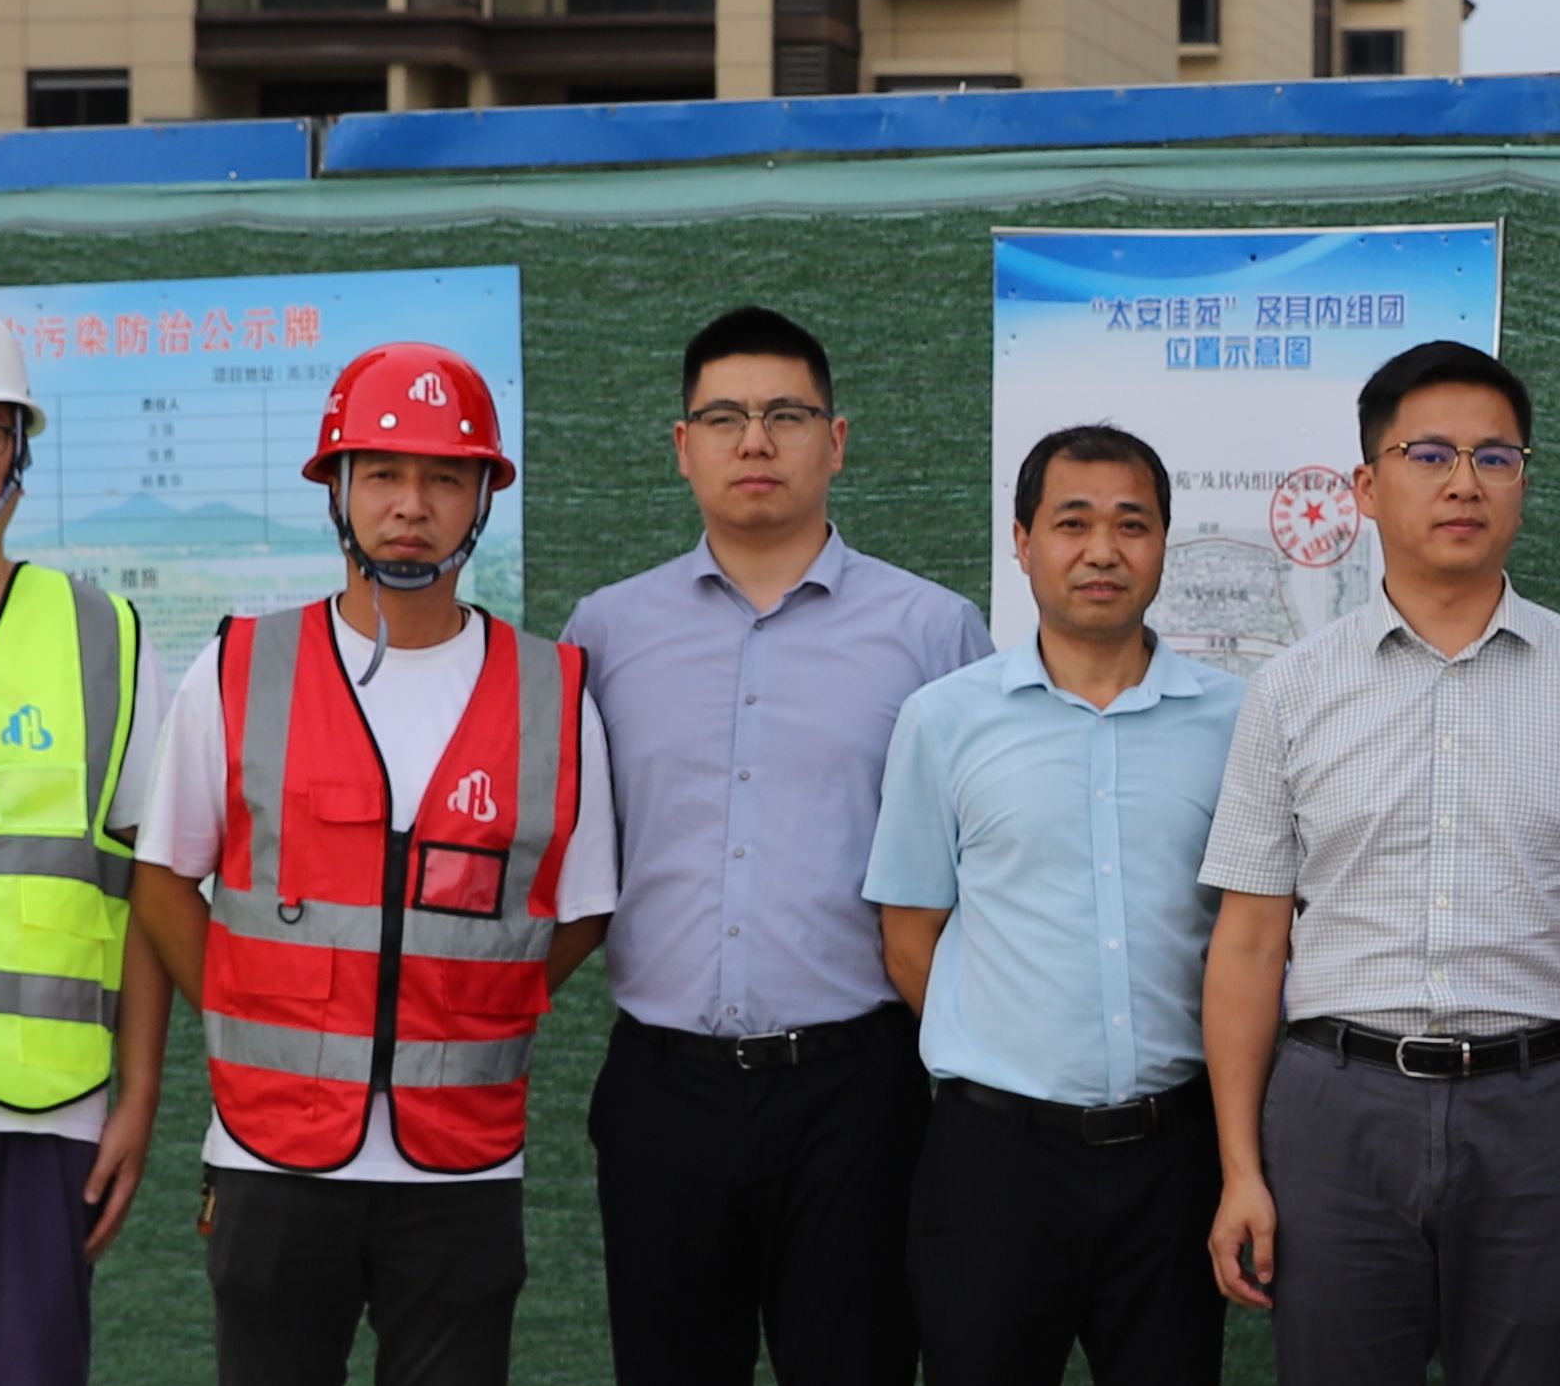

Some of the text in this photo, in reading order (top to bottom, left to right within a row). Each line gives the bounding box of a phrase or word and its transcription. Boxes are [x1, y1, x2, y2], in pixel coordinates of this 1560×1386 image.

[1255, 293, 1406, 329] 及其内组团
[1165, 334, 1313, 370] 位置示意图
